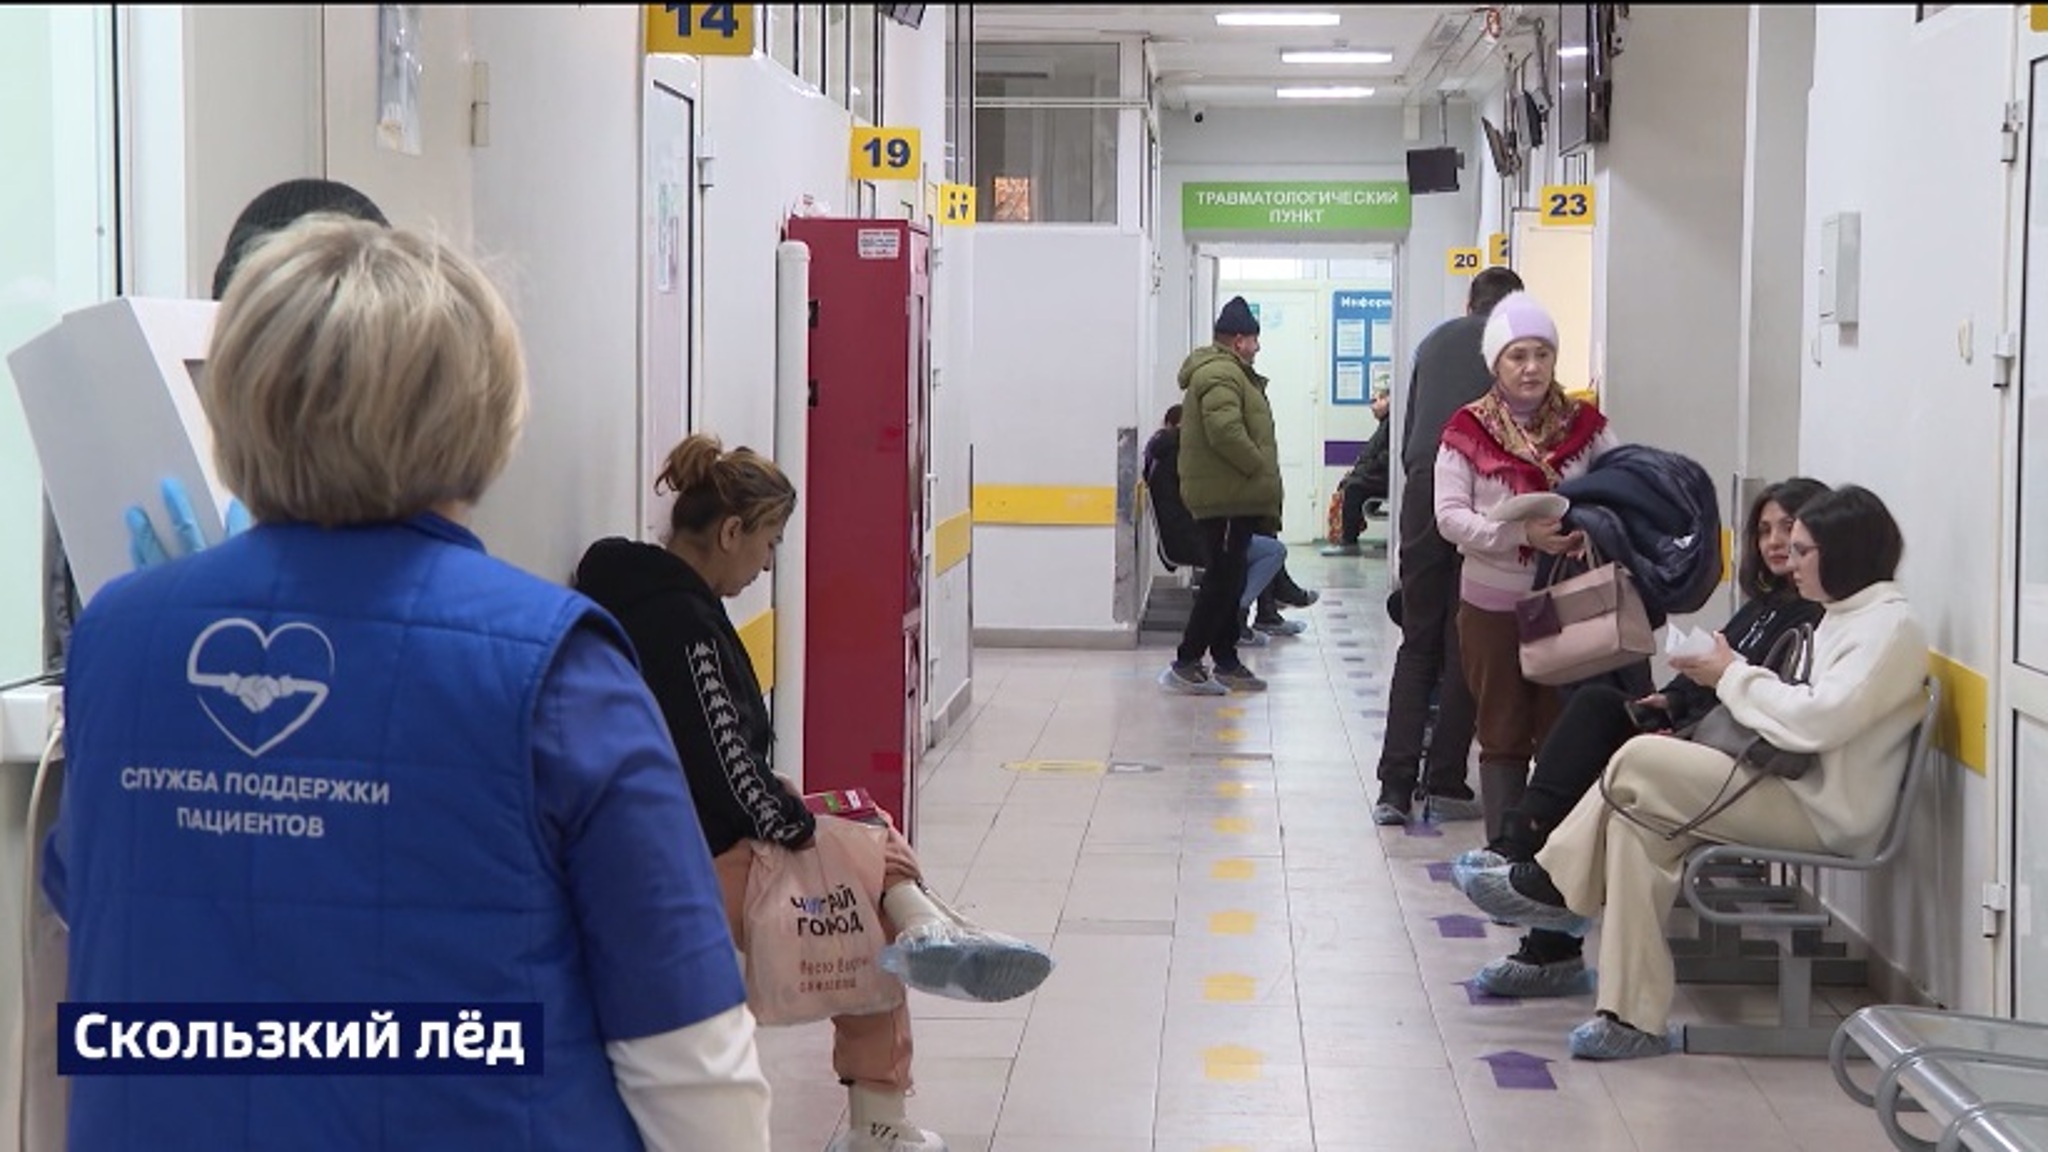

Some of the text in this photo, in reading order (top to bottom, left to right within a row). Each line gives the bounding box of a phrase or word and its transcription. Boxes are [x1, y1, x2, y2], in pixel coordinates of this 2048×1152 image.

[665, 4, 739, 38] 14
[863, 137, 912, 168] 19
[1196, 188, 1399, 206] ТРАВМАТОЛОГИЧЕСКИЙ
[1550, 194, 1588, 217] 23
[1269, 208, 1326, 224] ПУНКТ
[1453, 253, 1478, 269] 20
[120, 767, 391, 804] СЛУЖБА ПОДДЕРЖКИ
[176, 807, 326, 839] ПАЦИЕНТОВ
